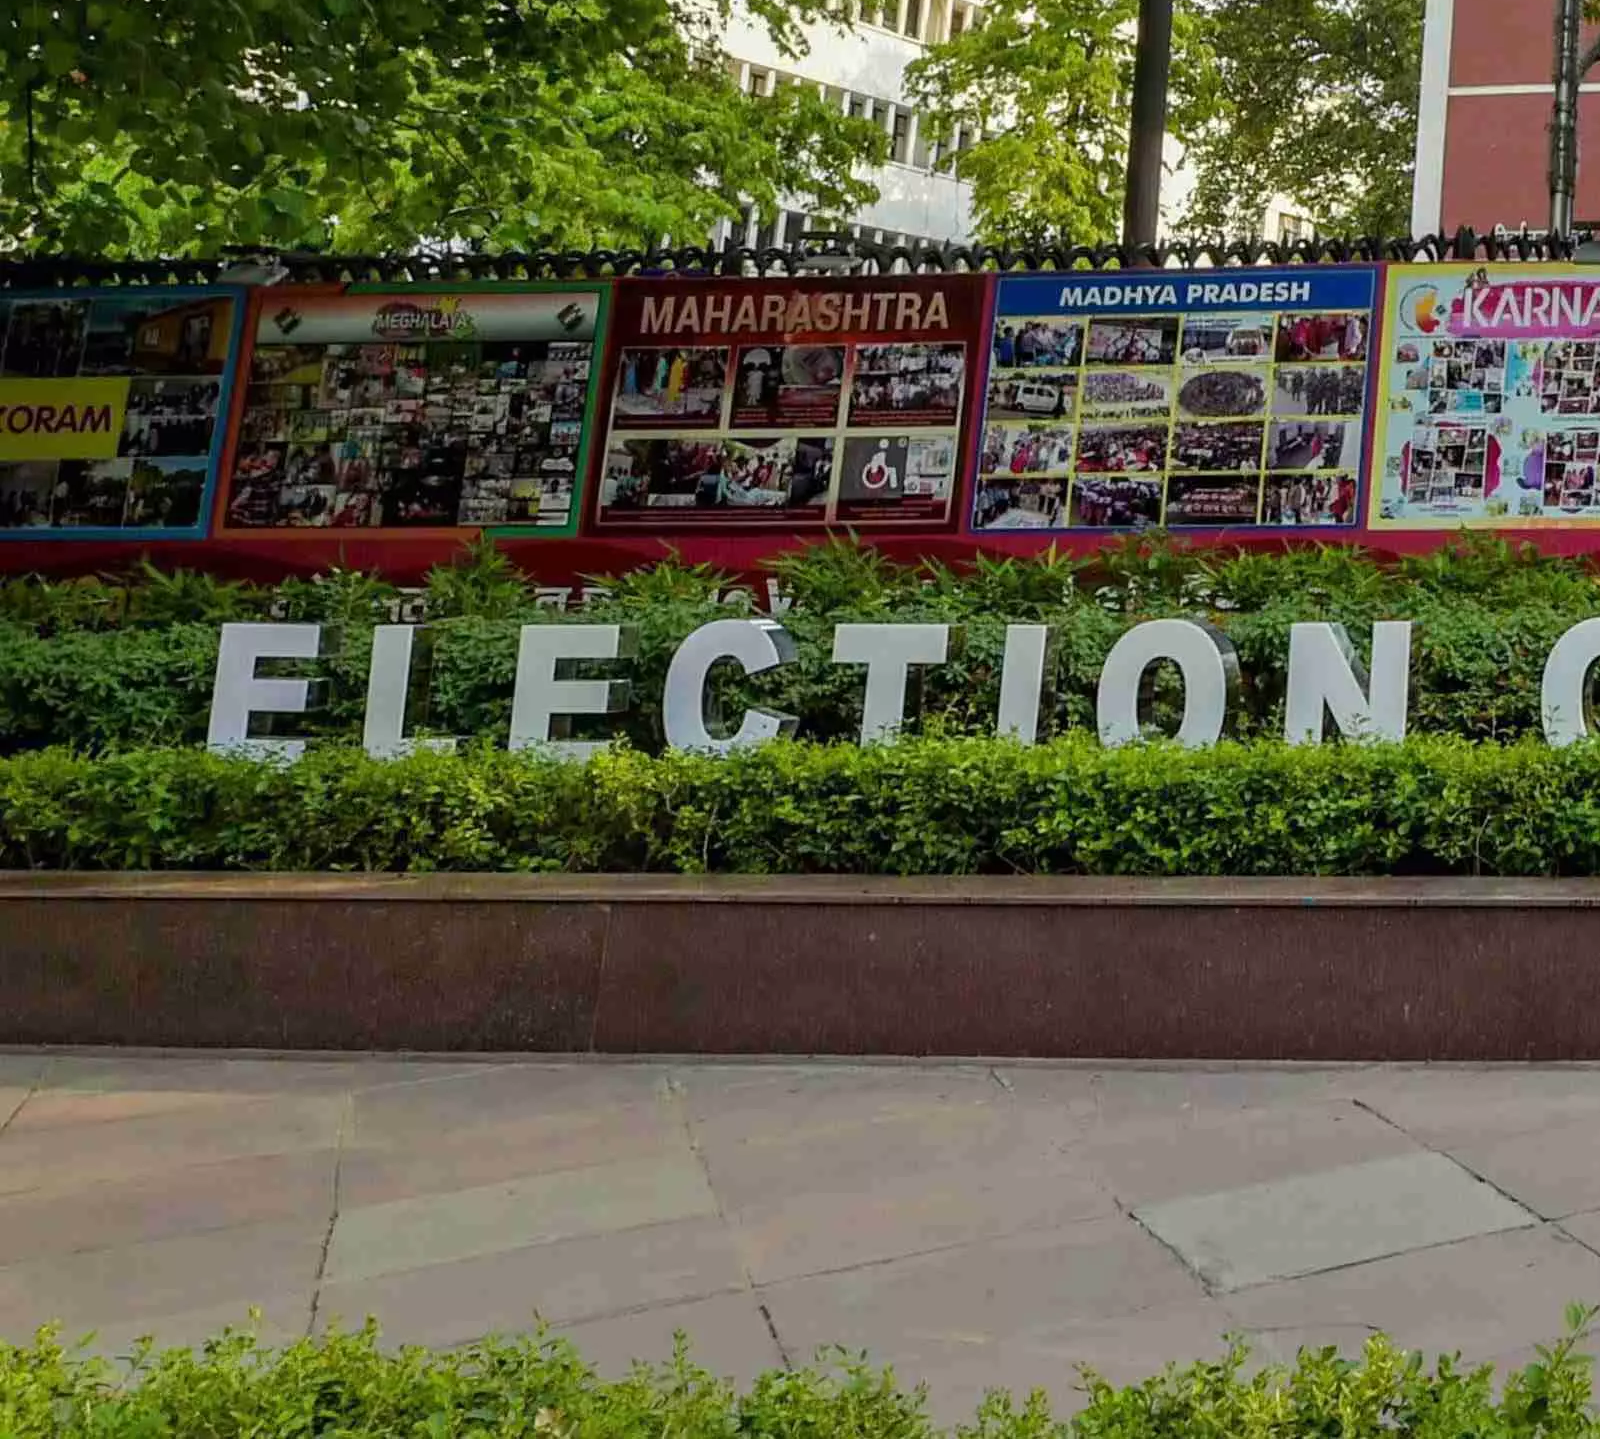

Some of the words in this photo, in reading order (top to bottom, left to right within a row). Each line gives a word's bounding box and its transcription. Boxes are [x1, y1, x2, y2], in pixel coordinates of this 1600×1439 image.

[1059, 284, 1177, 308] MADHYA
[1186, 281, 1312, 304] PRADESH
[375, 312, 468, 330] MEGHALAYA
[639, 292, 950, 335] MAHARASHTRA
[206, 617, 1414, 766] ELECTION
